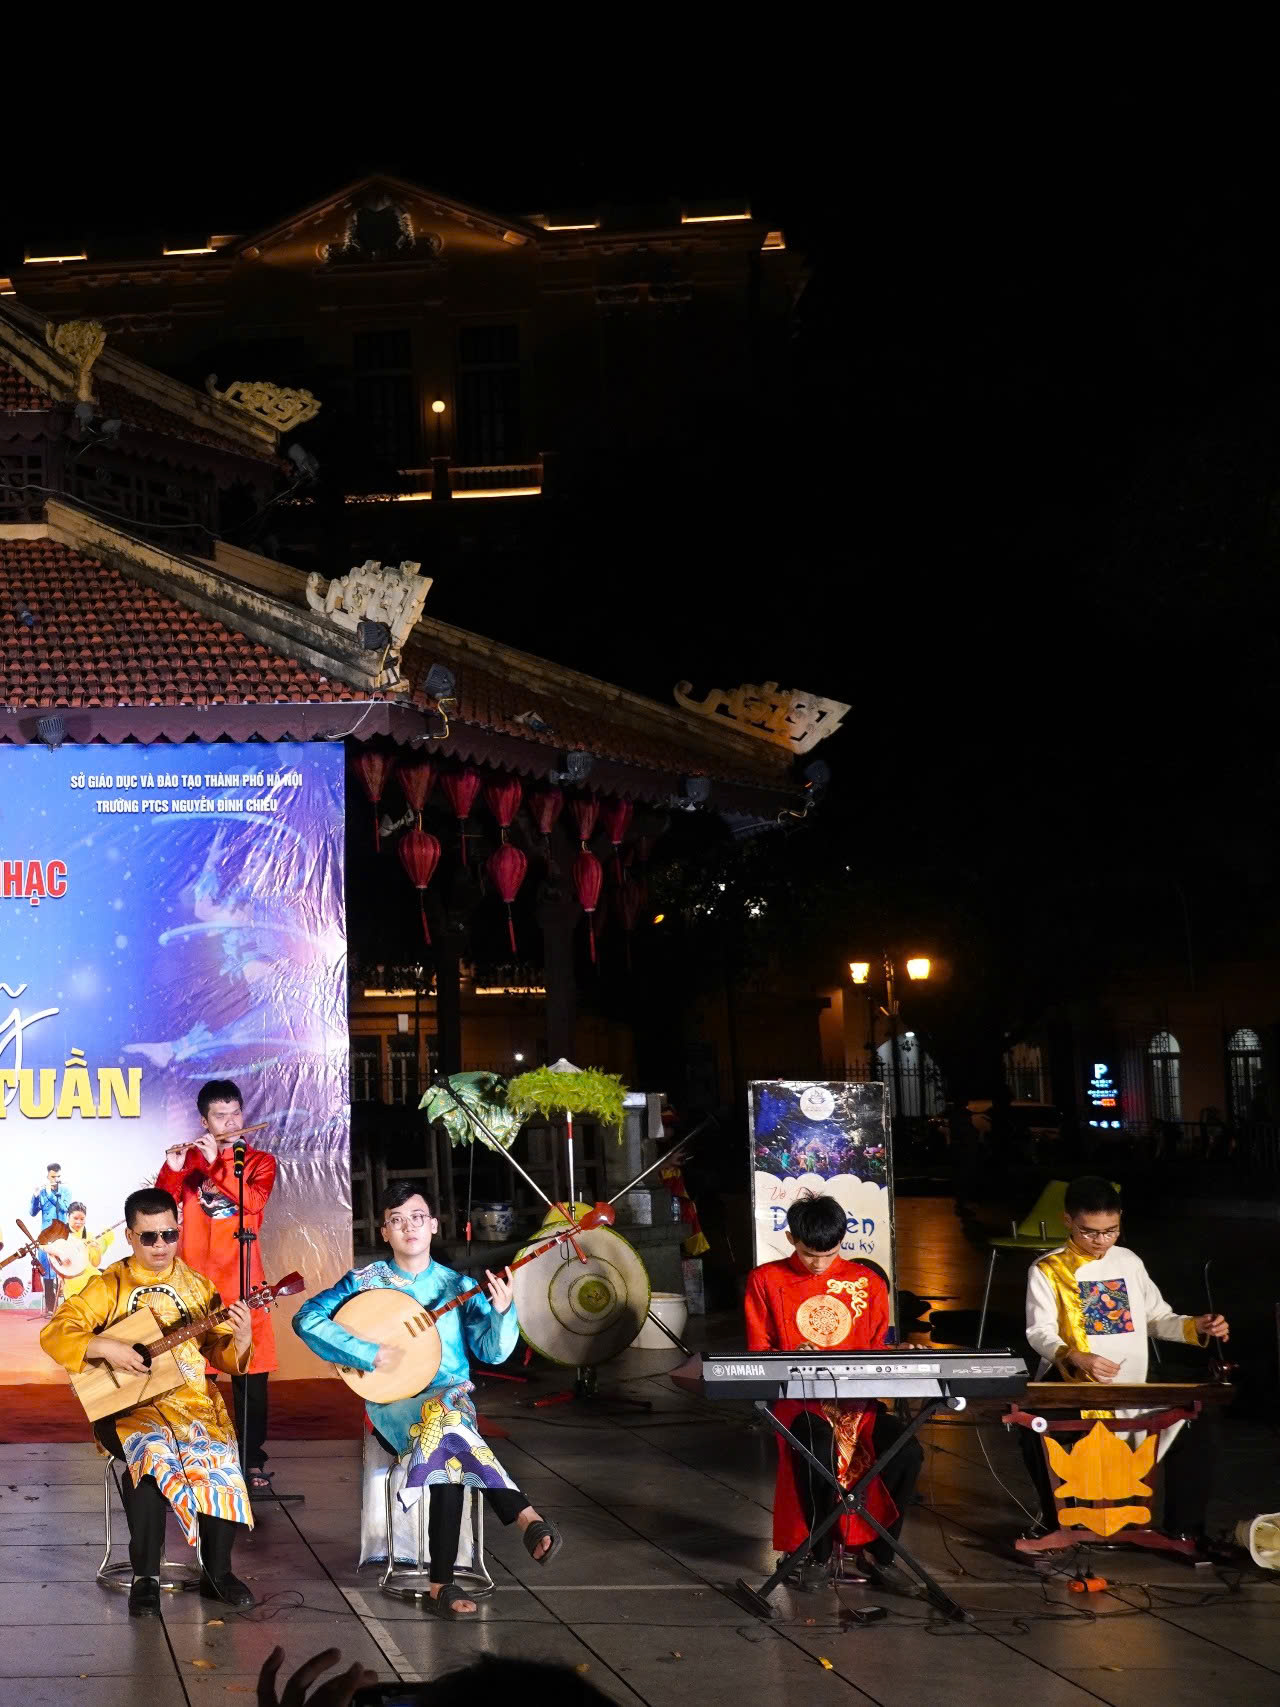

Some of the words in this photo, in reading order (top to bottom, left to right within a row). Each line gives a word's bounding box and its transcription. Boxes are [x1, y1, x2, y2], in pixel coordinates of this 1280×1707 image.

[70, 772, 85, 788] SỞ
[88, 773, 113, 788] GIÁO
[116, 775, 137, 791] DỤC
[140, 773, 154, 787] VÀ
[157, 773, 178, 787] ĐÀO
[181, 774, 201, 790] TẠO
[204, 772, 239, 786] THÀNH
[242, 770, 264, 786] PHỐ
[267, 772, 281, 786] HÀ
[284, 772, 302, 789] NỘI
[96, 797, 138, 813] TRƯỜNG
[141, 800, 168, 812] PTCS
[171, 795, 214, 812] NGUYỄN
[217, 796, 243, 811] ĐÌNH
[1094, 1063, 1108, 1079] P
[840, 1241, 855, 1250] ưu
[724, 1364, 766, 1376] YAMAHA
